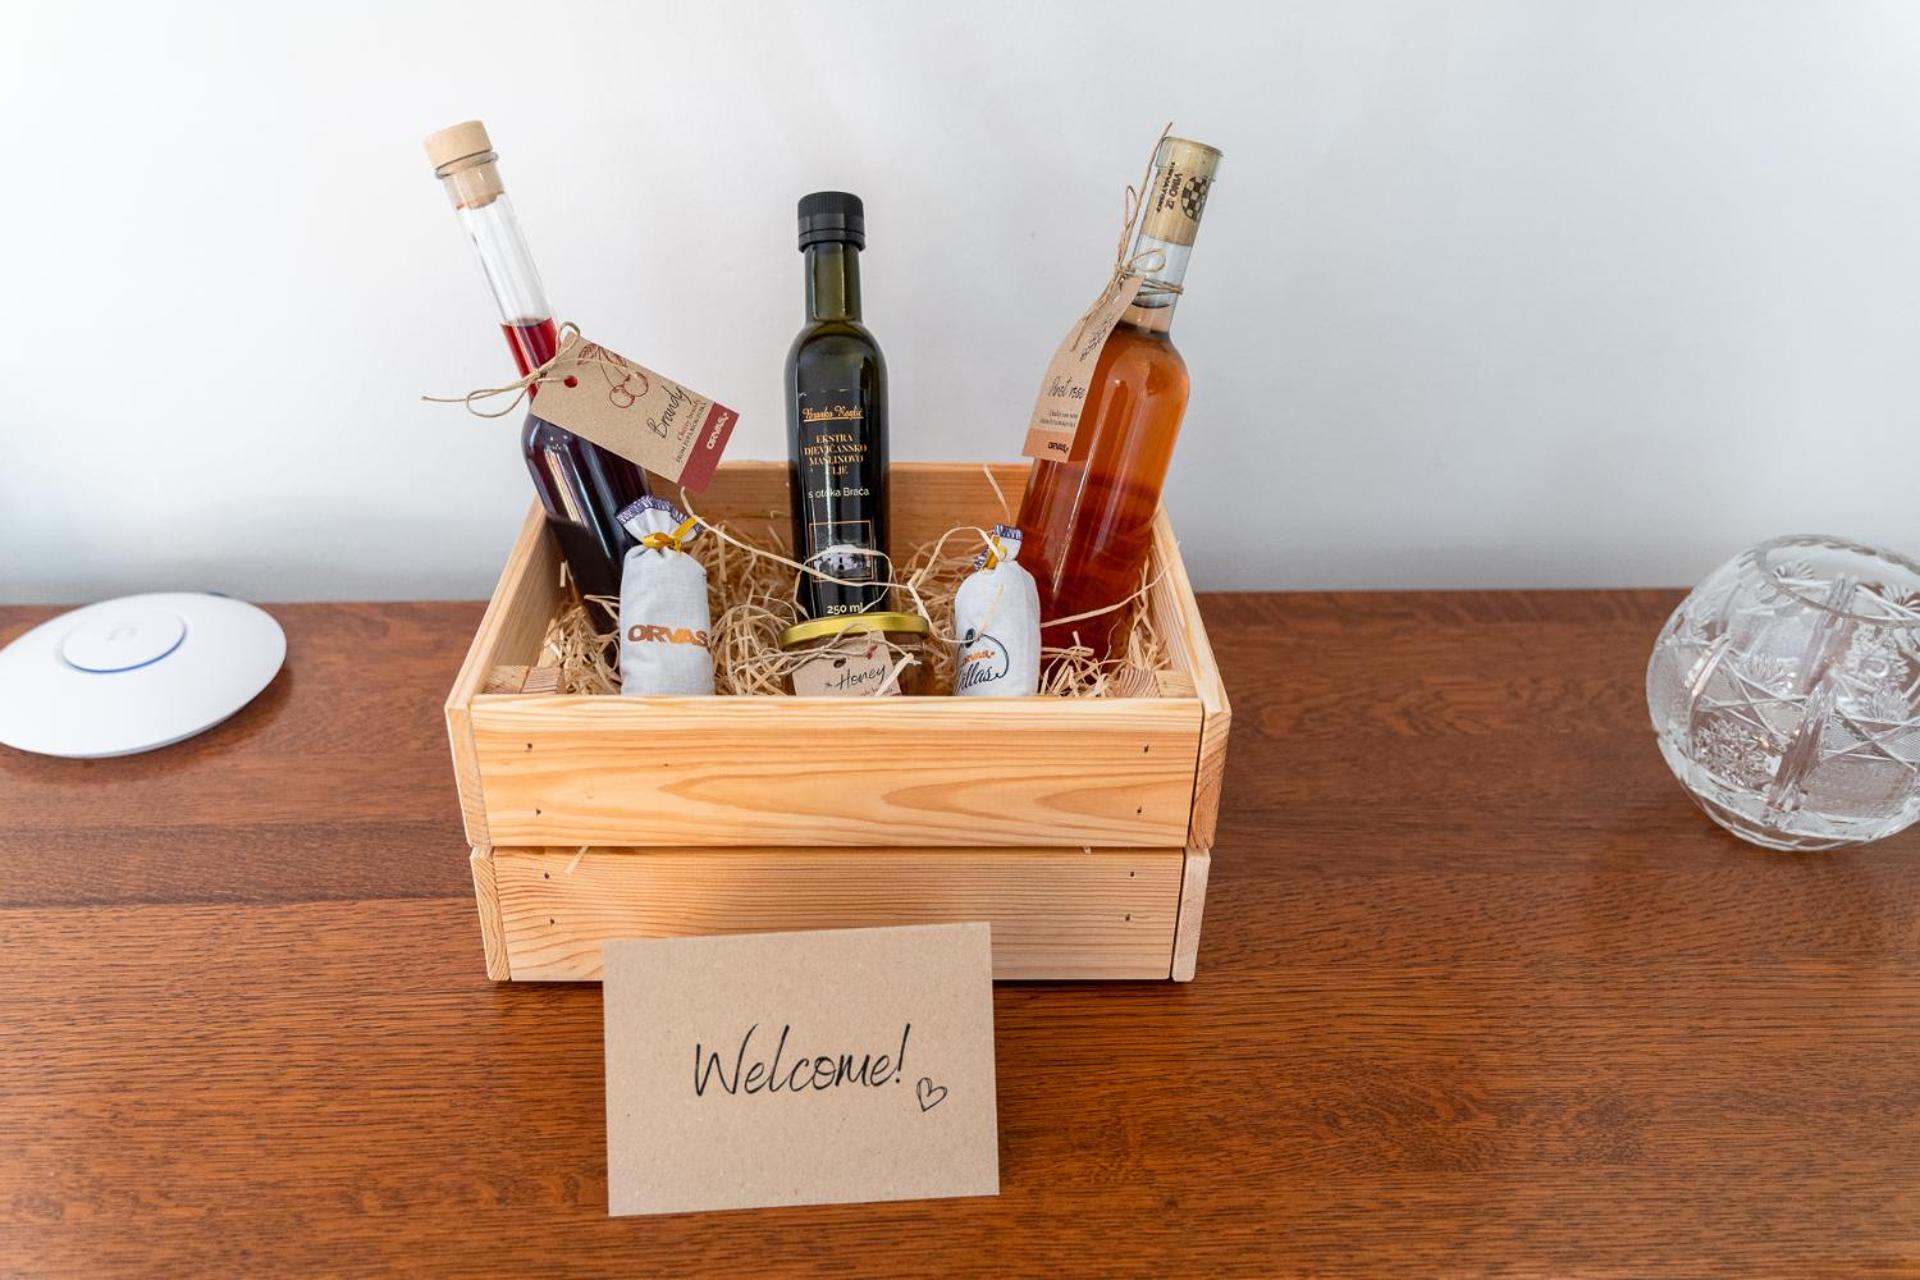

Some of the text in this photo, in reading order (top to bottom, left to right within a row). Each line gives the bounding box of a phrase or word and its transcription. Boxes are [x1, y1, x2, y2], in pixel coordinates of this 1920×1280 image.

[647, 385, 692, 439] Brandy
[816, 434, 854, 444] EKSTRA
[808, 491, 814, 499] s
[826, 602, 864, 615] 250 ml
[627, 624, 709, 647] ORVAS
[836, 665, 886, 690] Honey
[694, 1023, 911, 1097] Welcome!
